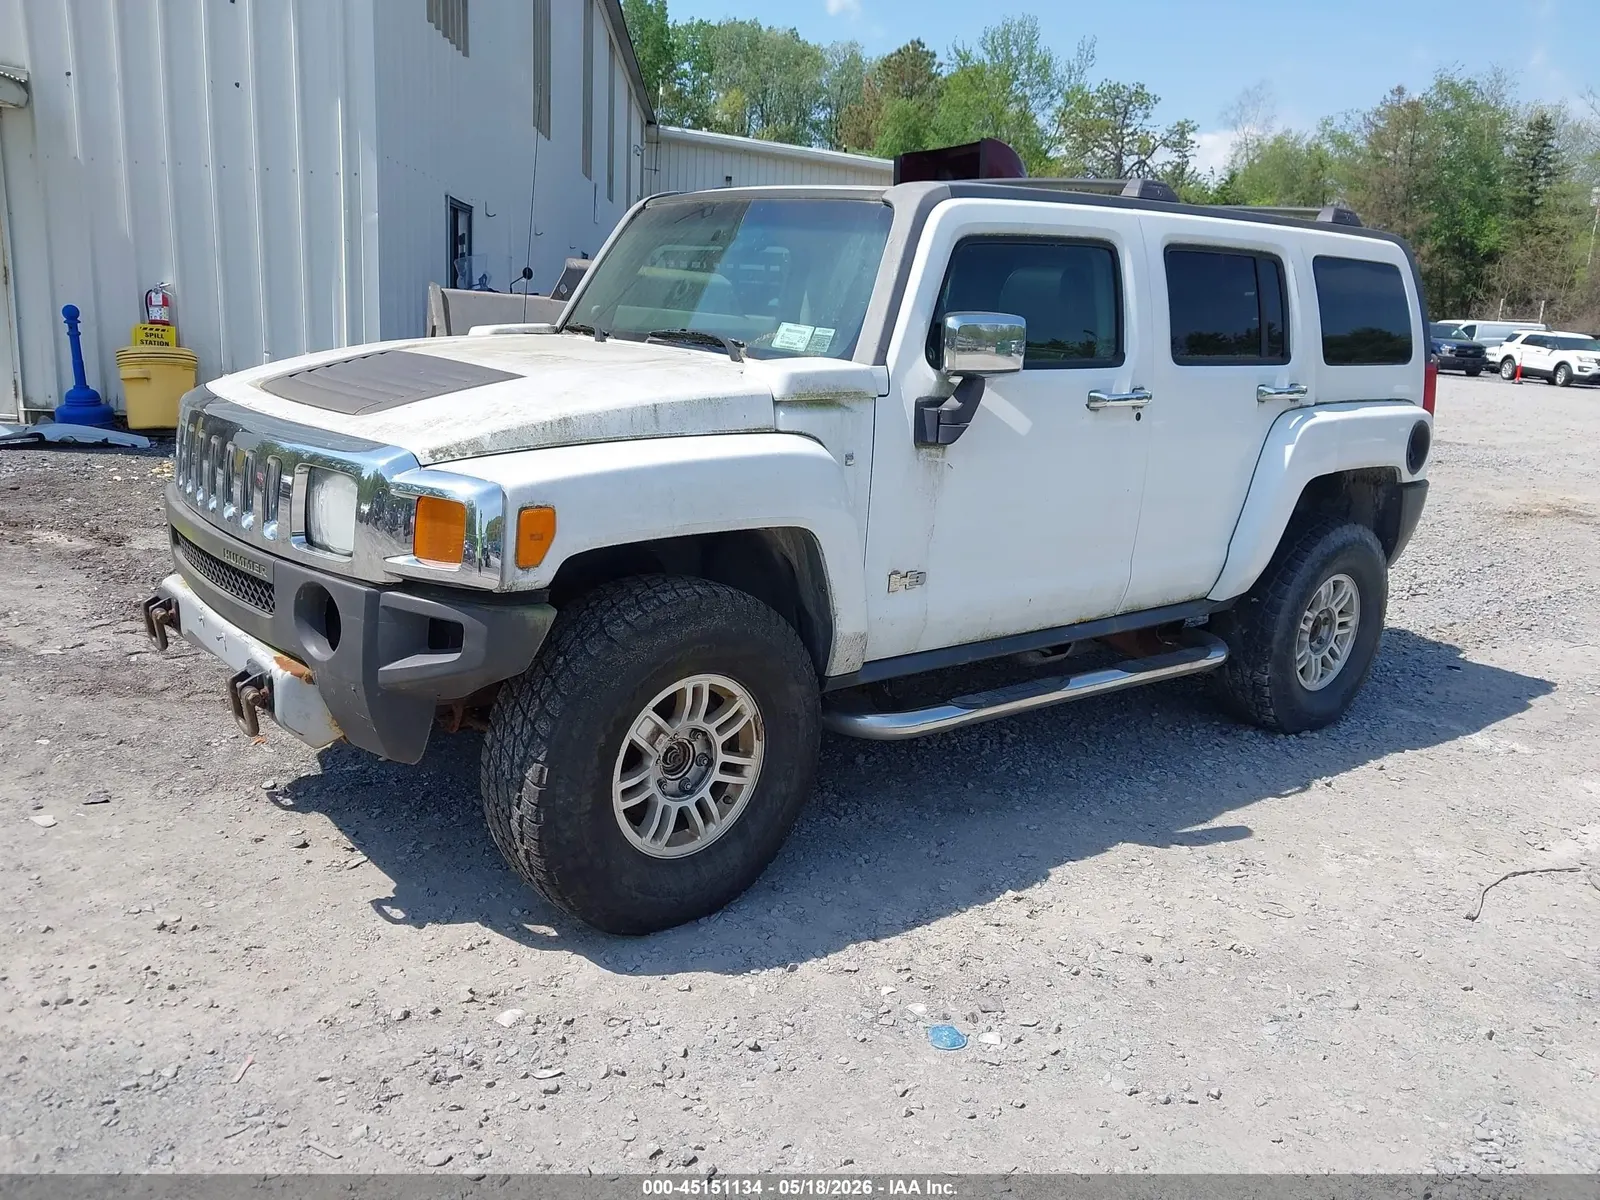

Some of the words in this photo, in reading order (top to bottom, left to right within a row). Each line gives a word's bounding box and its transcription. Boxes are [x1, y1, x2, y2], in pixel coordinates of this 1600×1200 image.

[144, 331, 165, 339] SPILL
[223, 548, 268, 578] HUMMER
[888, 570, 927, 593] H3
